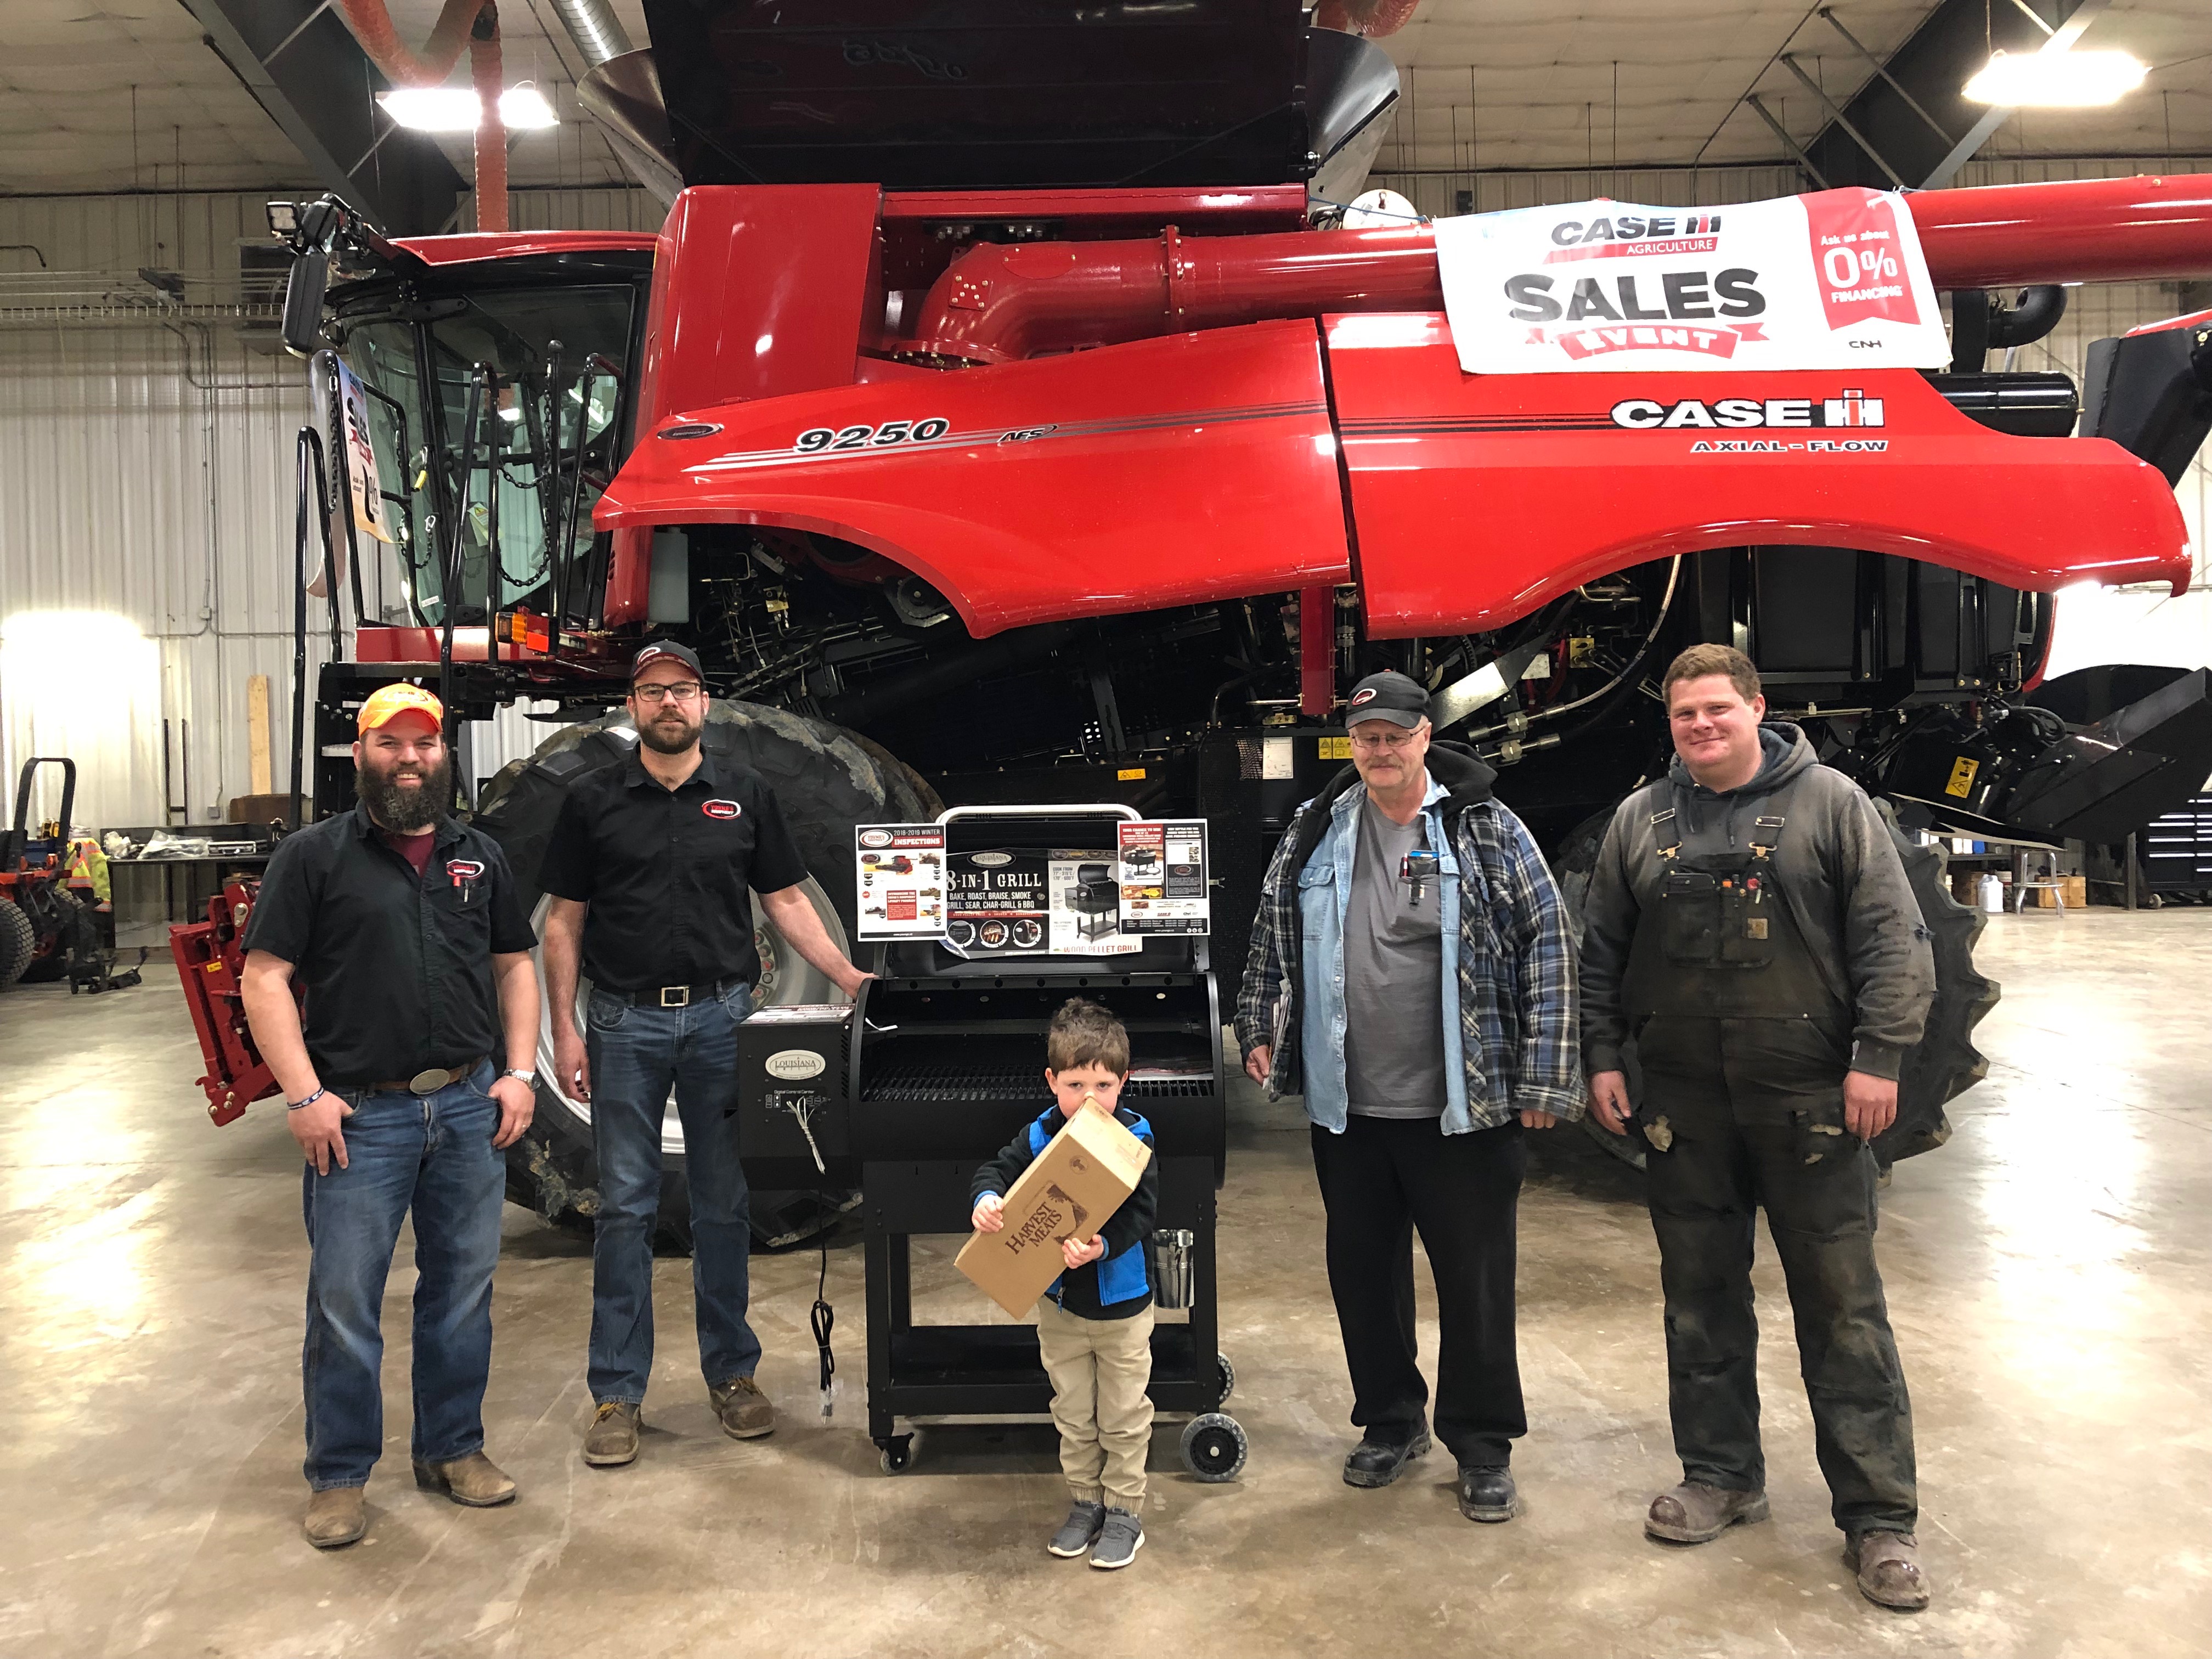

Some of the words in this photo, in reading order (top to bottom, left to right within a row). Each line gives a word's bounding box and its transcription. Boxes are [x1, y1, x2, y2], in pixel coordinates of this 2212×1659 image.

[1551, 216, 1676, 246] CASE
[1821, 235, 1841, 246] Ask
[1844, 234, 1857, 243] us
[1860, 230, 1890, 241] about
[1627, 239, 1713, 255] AGRICULTURE
[1824, 247, 1898, 288] 0%
[1504, 268, 1766, 321] SALES
[1831, 285, 1903, 303] FINANCING
[1575, 328, 1718, 351] EVENT
[1611, 398, 1812, 428] CASE
[1822, 388, 1884, 428] IH
[793, 417, 950, 453] 9250
[996, 428, 1045, 442] AFS
[946, 870, 991, 891] 8-IN-1
[997, 873, 1042, 887] GRILL
[947, 901, 964, 910] GRILL,
[965, 901, 981, 910] SEAR,
[983, 900, 1017, 909] CHAR-GRILL
[1023, 900, 1035, 909] BBQ
[950, 892, 966, 900] BAKE,
[967, 892, 987, 900] ROAST,
[988, 891, 1010, 900] BRAISE,
[1011, 891, 1031, 900] SMOKE
[775, 1059, 816, 1068] LOUISIANA
[1005, 1201, 1052, 1255] HARVEST
[1029, 1210, 1062, 1247] MEATS
